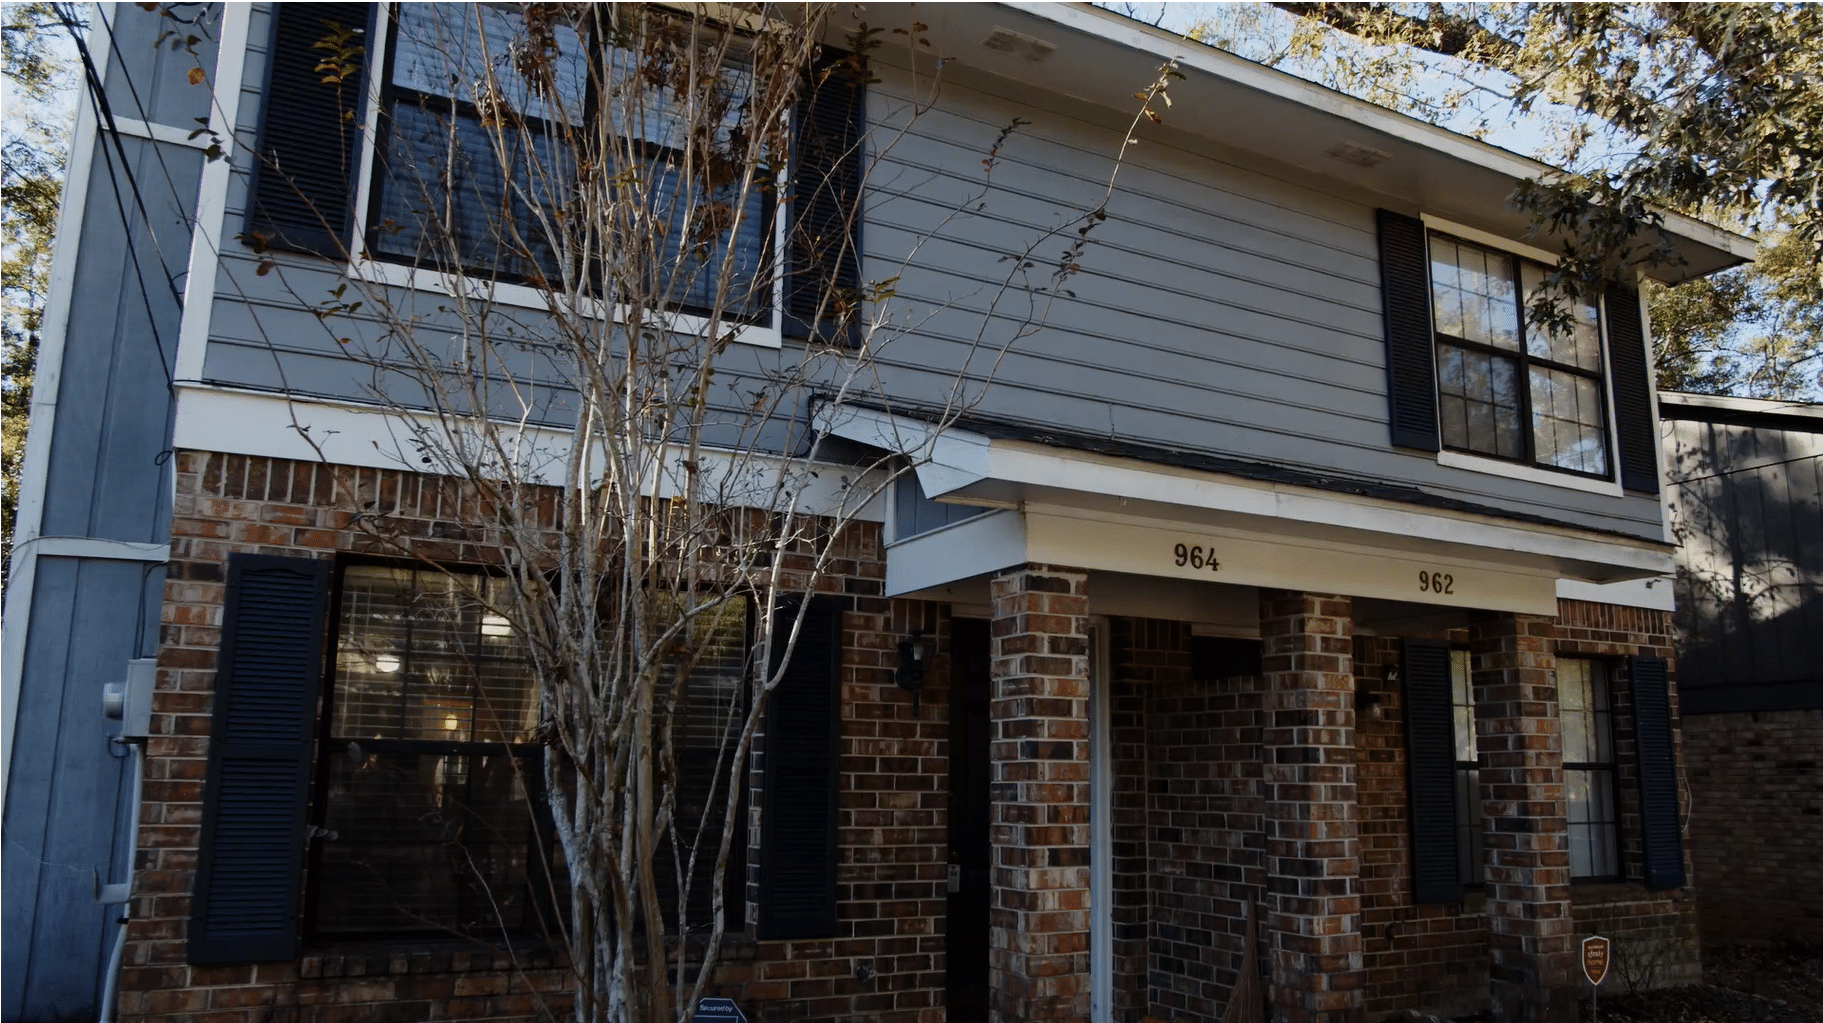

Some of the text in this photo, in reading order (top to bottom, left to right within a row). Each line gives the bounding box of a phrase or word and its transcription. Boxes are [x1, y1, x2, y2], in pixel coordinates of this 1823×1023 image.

[1174, 543, 1220, 571] 964
[1419, 570, 1454, 595] 962
[699, 1003, 734, 1013] Secured by
